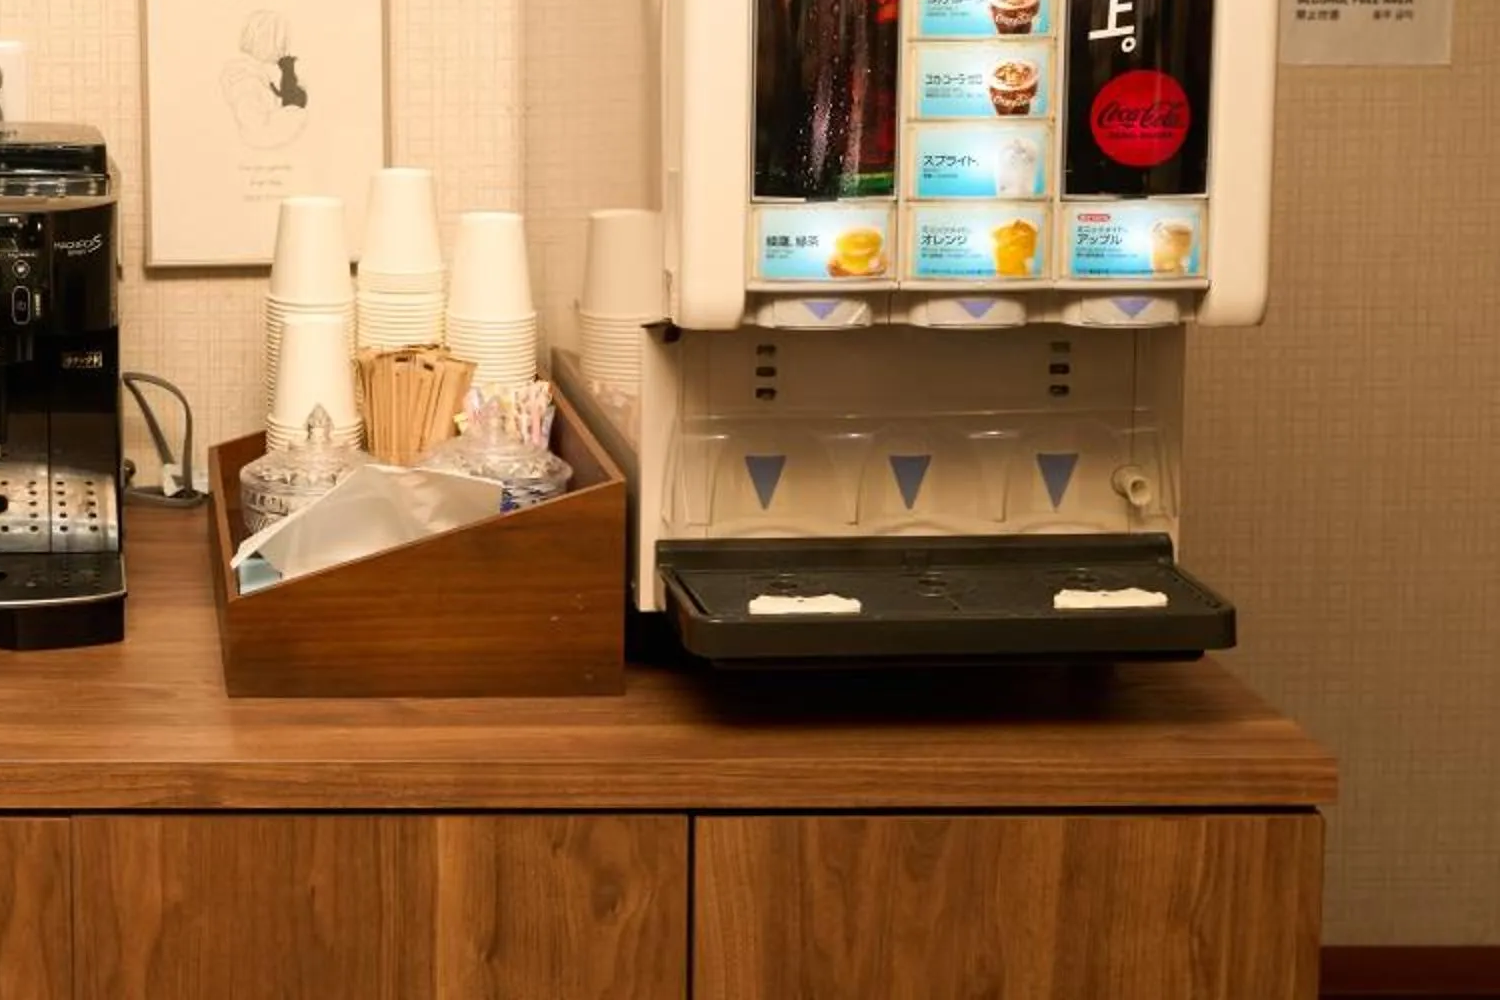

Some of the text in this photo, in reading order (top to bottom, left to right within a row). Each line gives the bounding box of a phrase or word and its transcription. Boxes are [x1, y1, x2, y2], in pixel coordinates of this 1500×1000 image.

[923, 155, 977, 167] スプライト
[920, 234, 967, 246] オレンジ
[1077, 234, 1123, 245] アップル
